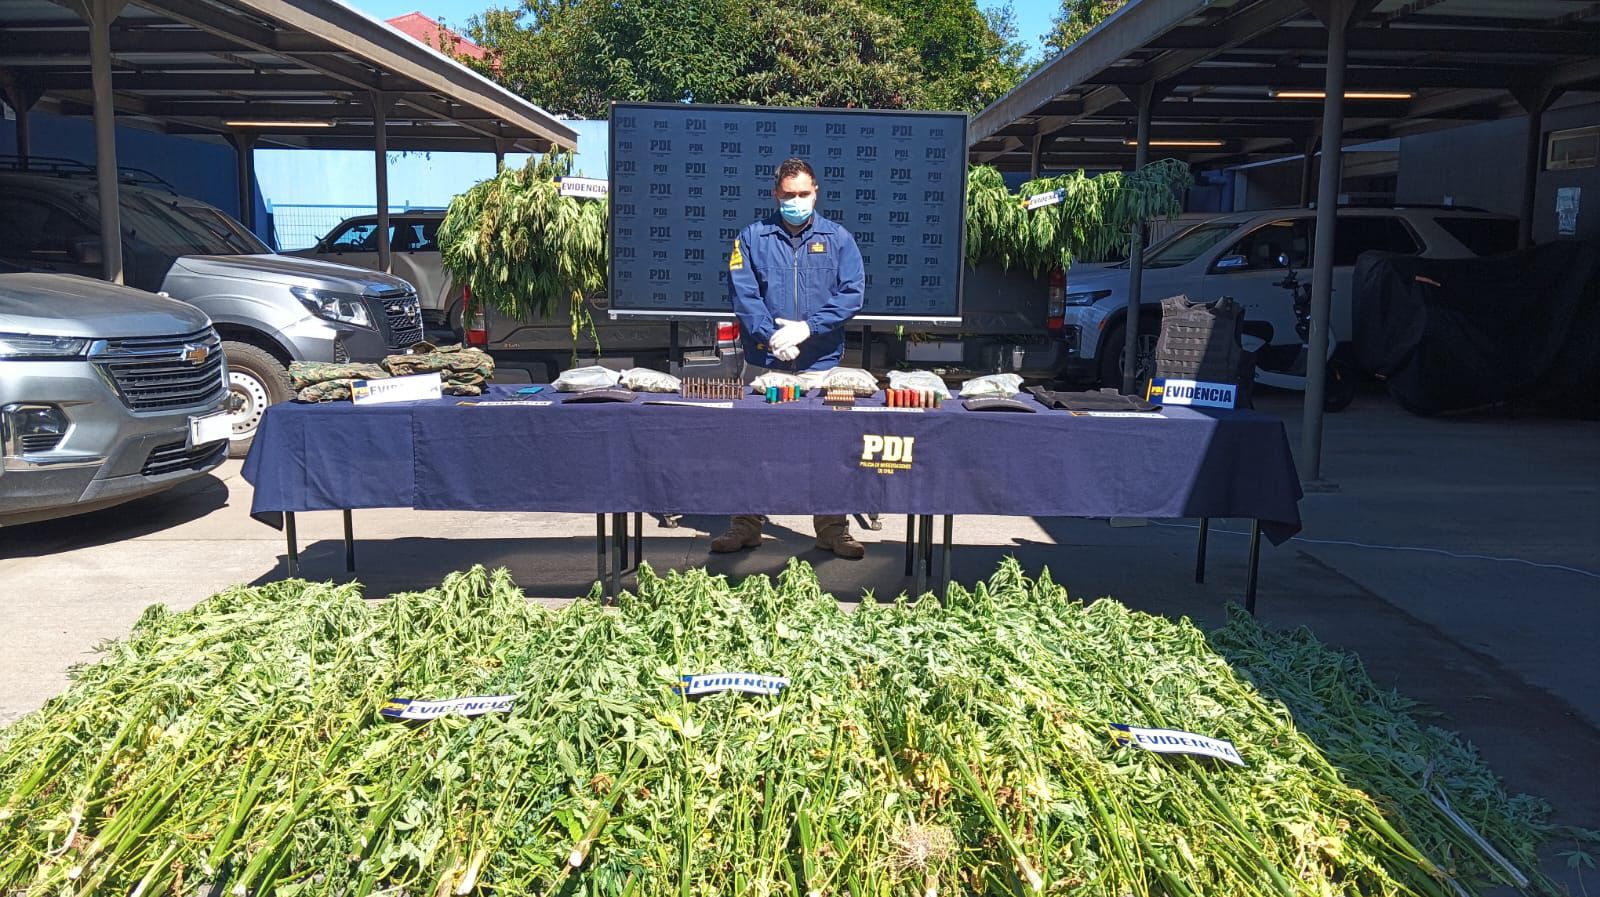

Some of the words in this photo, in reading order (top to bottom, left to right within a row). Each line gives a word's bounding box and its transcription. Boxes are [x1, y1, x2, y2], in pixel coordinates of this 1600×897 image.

[616, 117, 636, 128] PDI
[686, 118, 706, 130] PDI
[756, 122, 776, 132] PDI
[826, 124, 846, 134] PDI
[892, 126, 912, 136] PDI
[650, 140, 672, 151] PDI
[720, 142, 742, 153] PDI
[790, 144, 810, 155] PDI
[857, 146, 877, 156] PDI
[926, 148, 946, 158] PDI
[616, 161, 636, 172] PDI
[686, 163, 706, 174] PDI
[824, 167, 844, 178] PDI
[890, 168, 912, 179] PDI
[562, 183, 606, 192] EVIDENCIA
[650, 184, 672, 194] PDI
[720, 186, 741, 196] PDI
[856, 189, 876, 200] PDI
[924, 191, 944, 202] PDI
[616, 204, 636, 214] PDI
[685, 206, 705, 217] PDI
[824, 210, 843, 220] PDI
[890, 212, 910, 222] PDI
[650, 227, 670, 237] PDI
[923, 234, 942, 244] PDI
[616, 247, 636, 257] PDI
[684, 249, 704, 260] PDI
[888, 254, 908, 264] PDI
[650, 270, 670, 280] PDI
[921, 276, 940, 286] PDI
[684, 292, 704, 302] PDI
[886, 296, 906, 306] PDI
[1166, 386, 1232, 402] EVIDENCIA
[862, 434, 914, 462] PDI
[1135, 734, 1235, 757] EVIDENCIA
